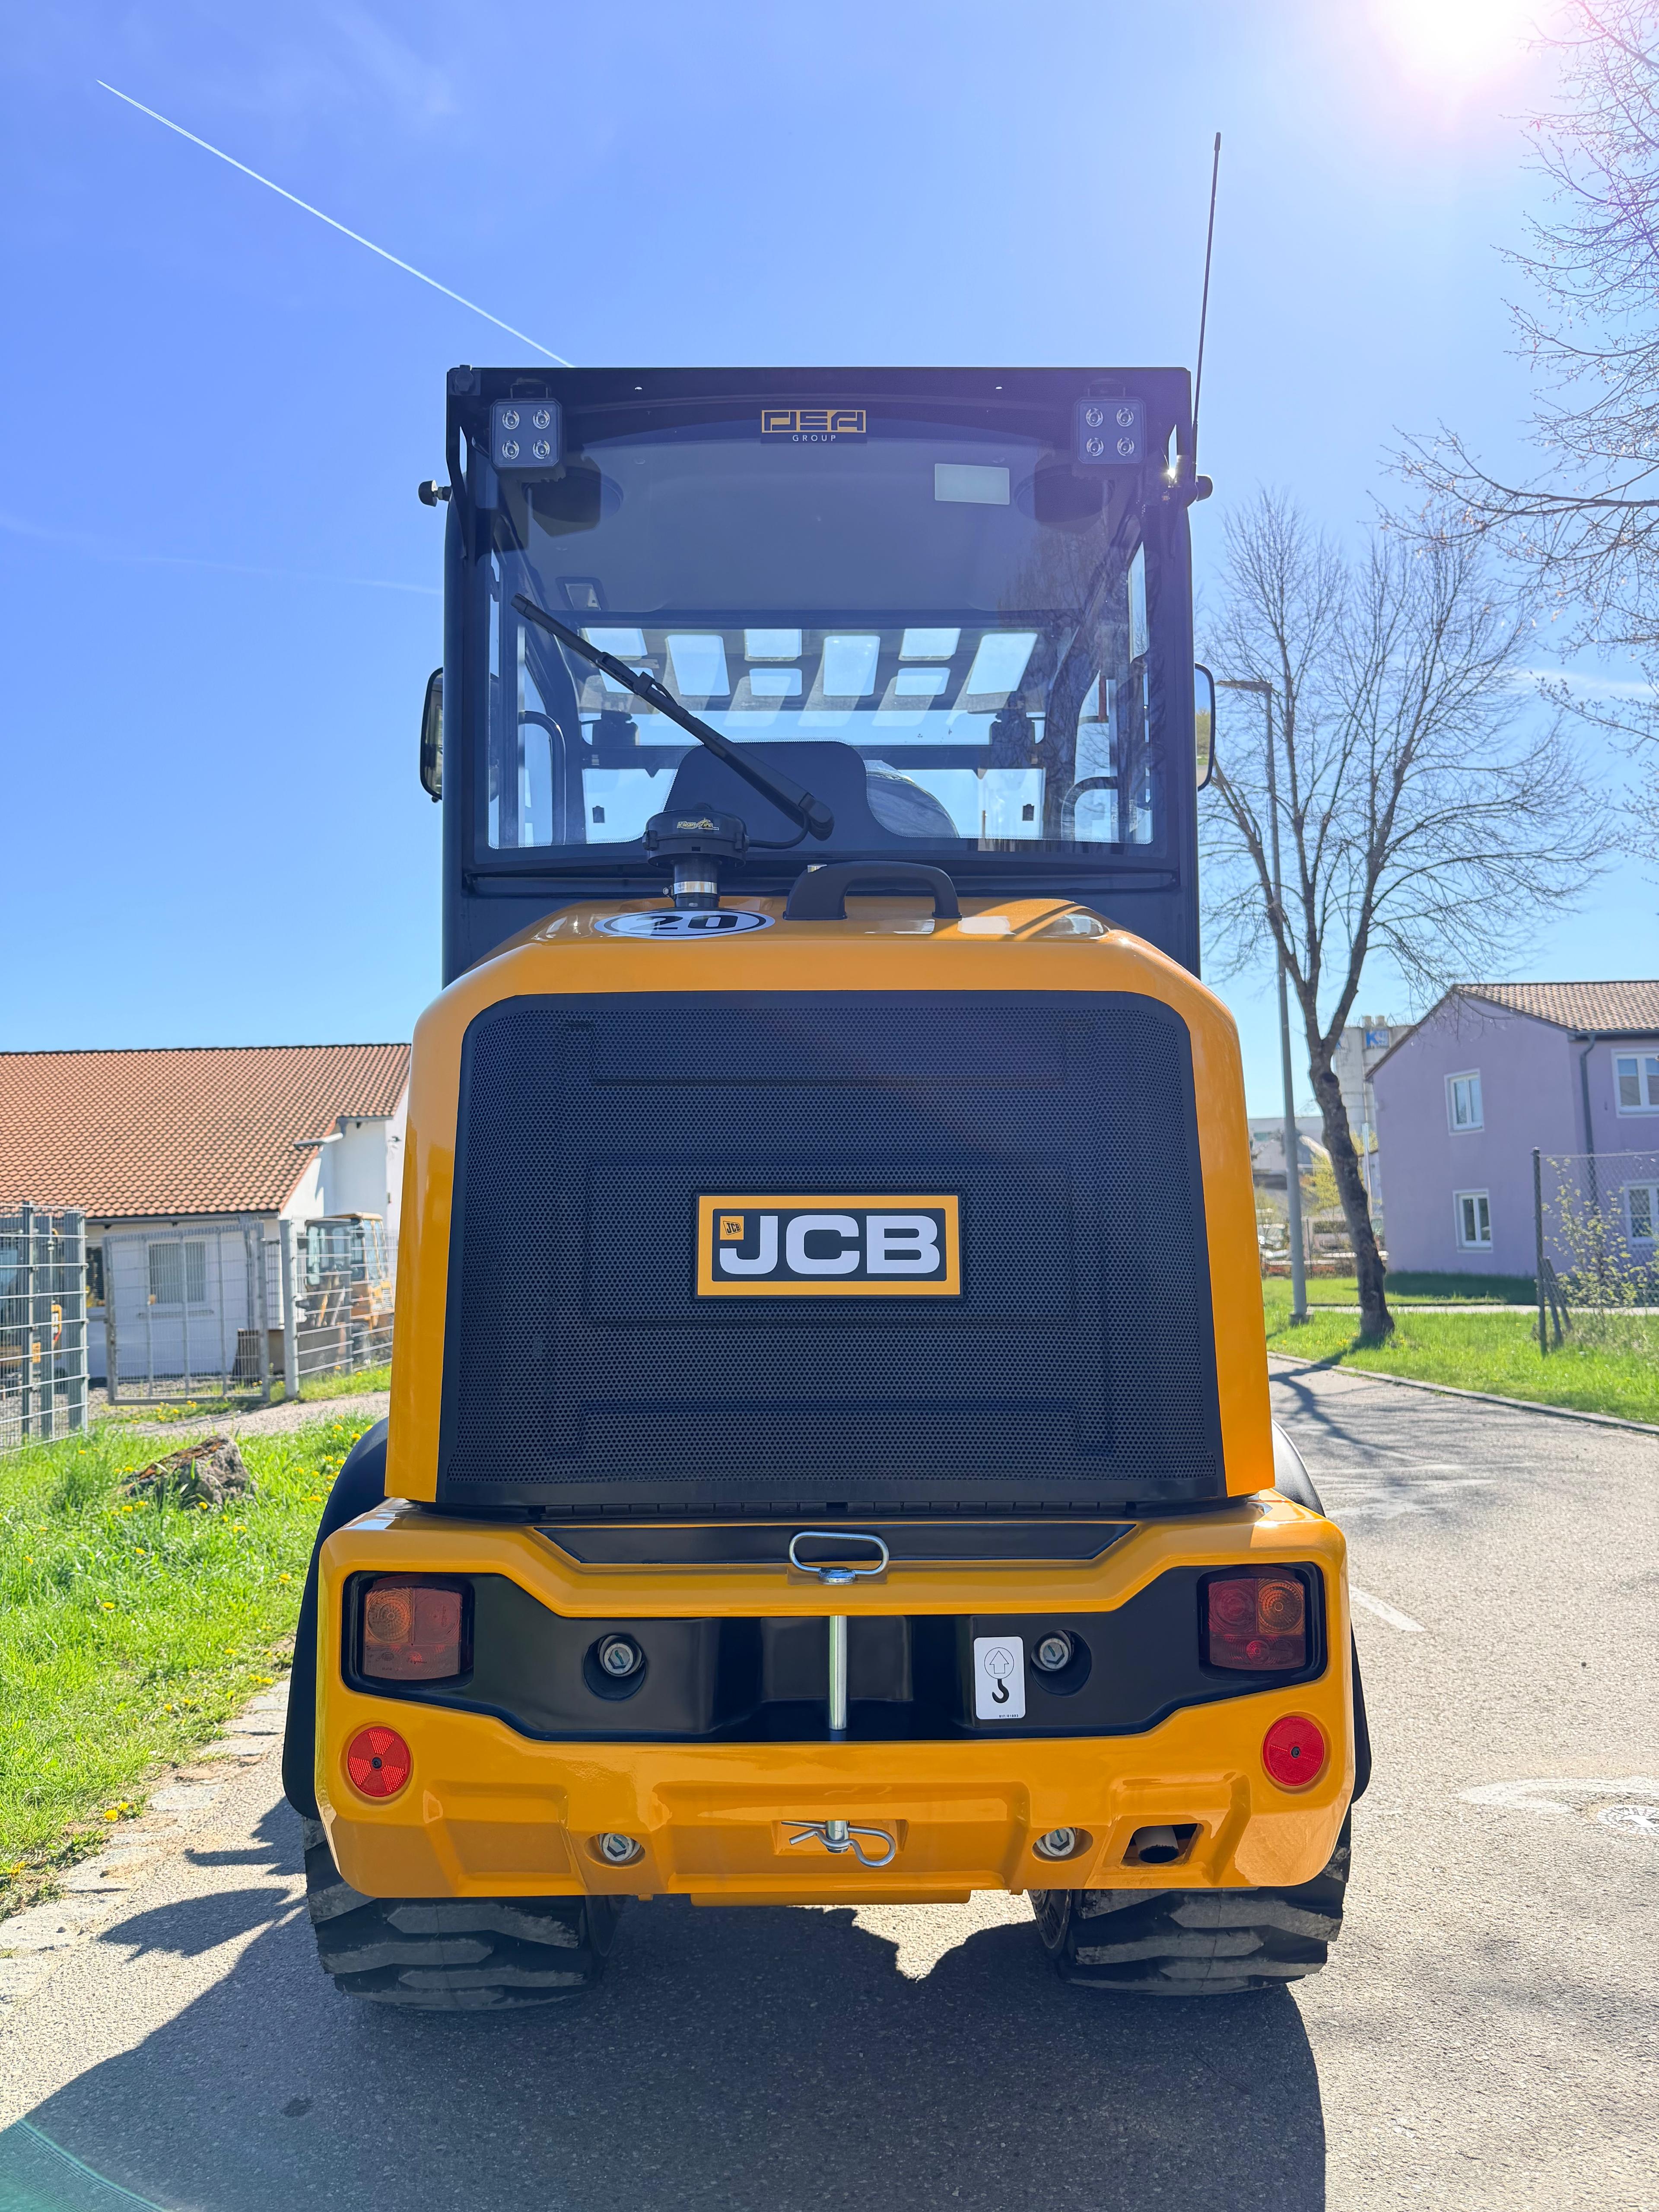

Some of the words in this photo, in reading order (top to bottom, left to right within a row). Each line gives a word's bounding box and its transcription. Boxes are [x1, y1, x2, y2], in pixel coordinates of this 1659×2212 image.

[629, 915, 738, 930] 20
[727, 1223, 740, 1233] JCB
[720, 1215, 940, 1274] JCB
